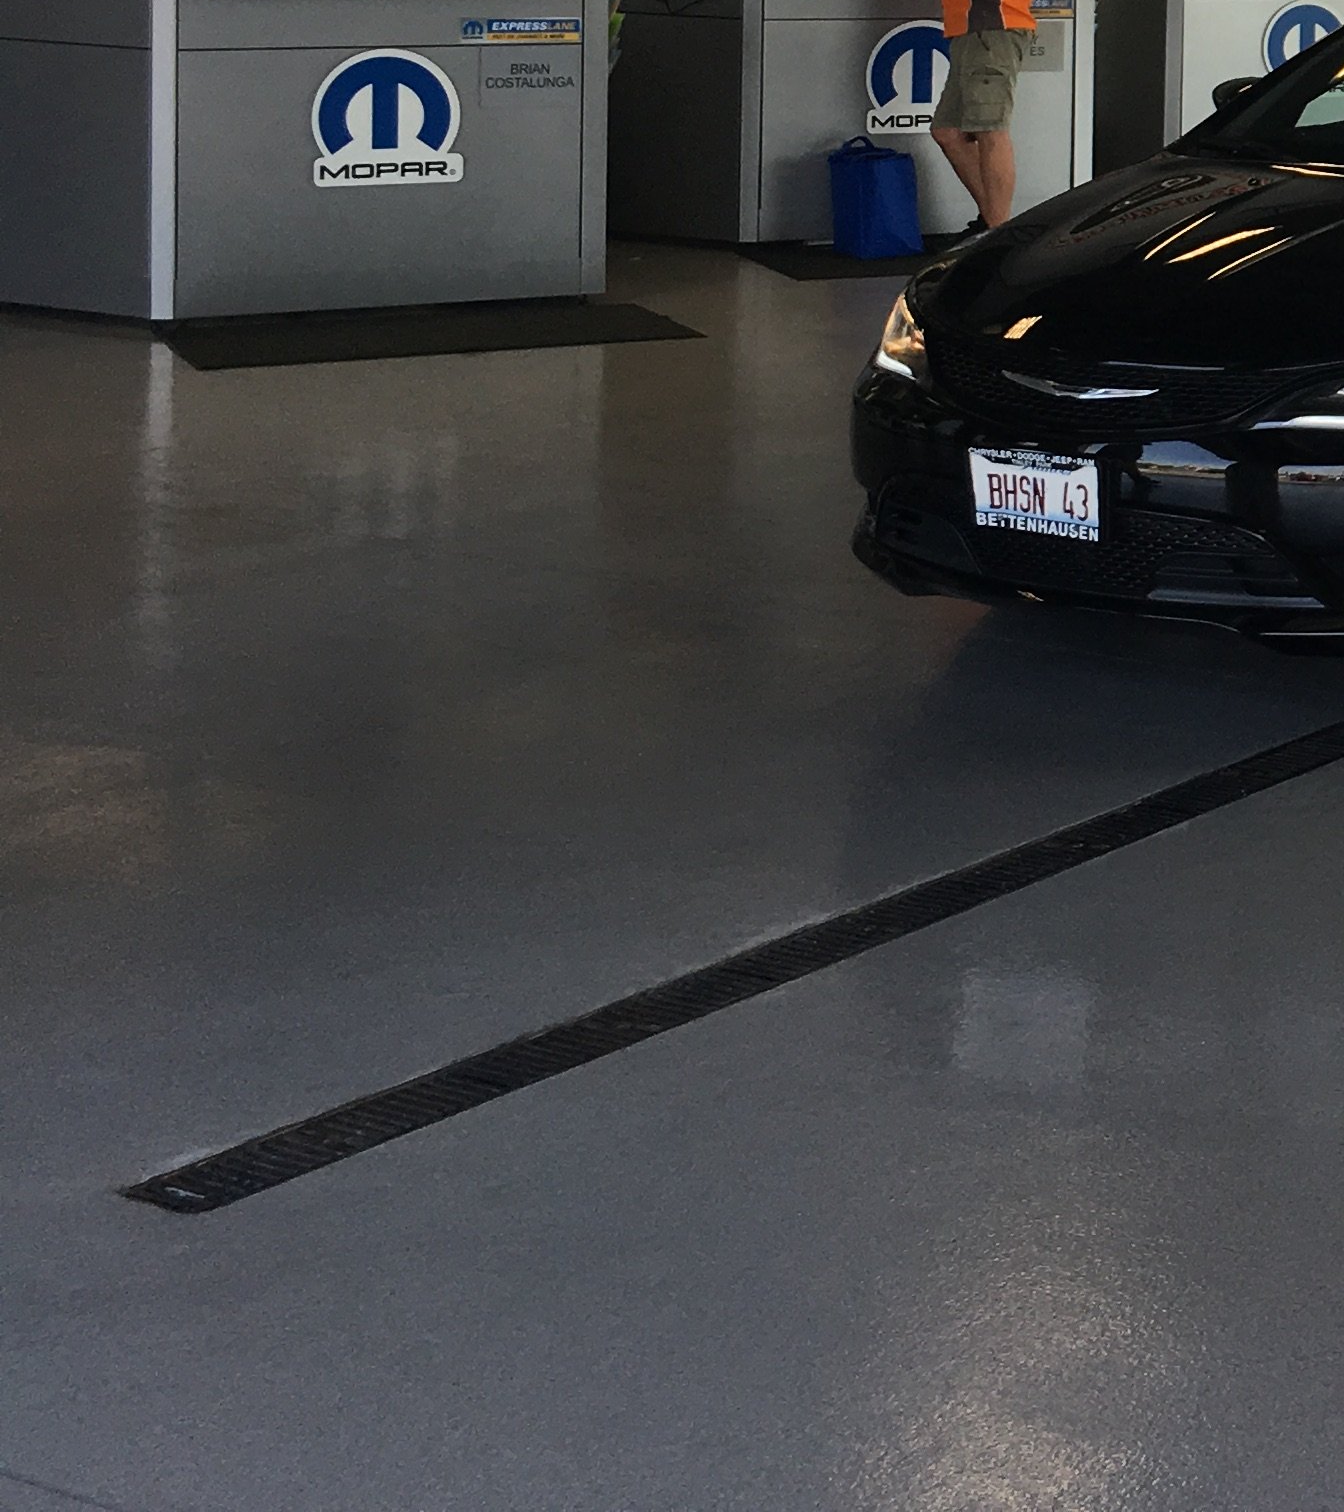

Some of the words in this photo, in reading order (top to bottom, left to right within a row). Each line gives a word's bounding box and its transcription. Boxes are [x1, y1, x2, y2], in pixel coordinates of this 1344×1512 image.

[511, 63, 550, 75] BRIAN
[485, 76, 575, 89] COSTALUNGA
[872, 114, 933, 128] MOP
[319, 160, 449, 182] MOPAR
[988, 473, 1046, 516] BHSN
[1063, 482, 1089, 521] 43
[976, 512, 1099, 542] BETTENHAUSEN
